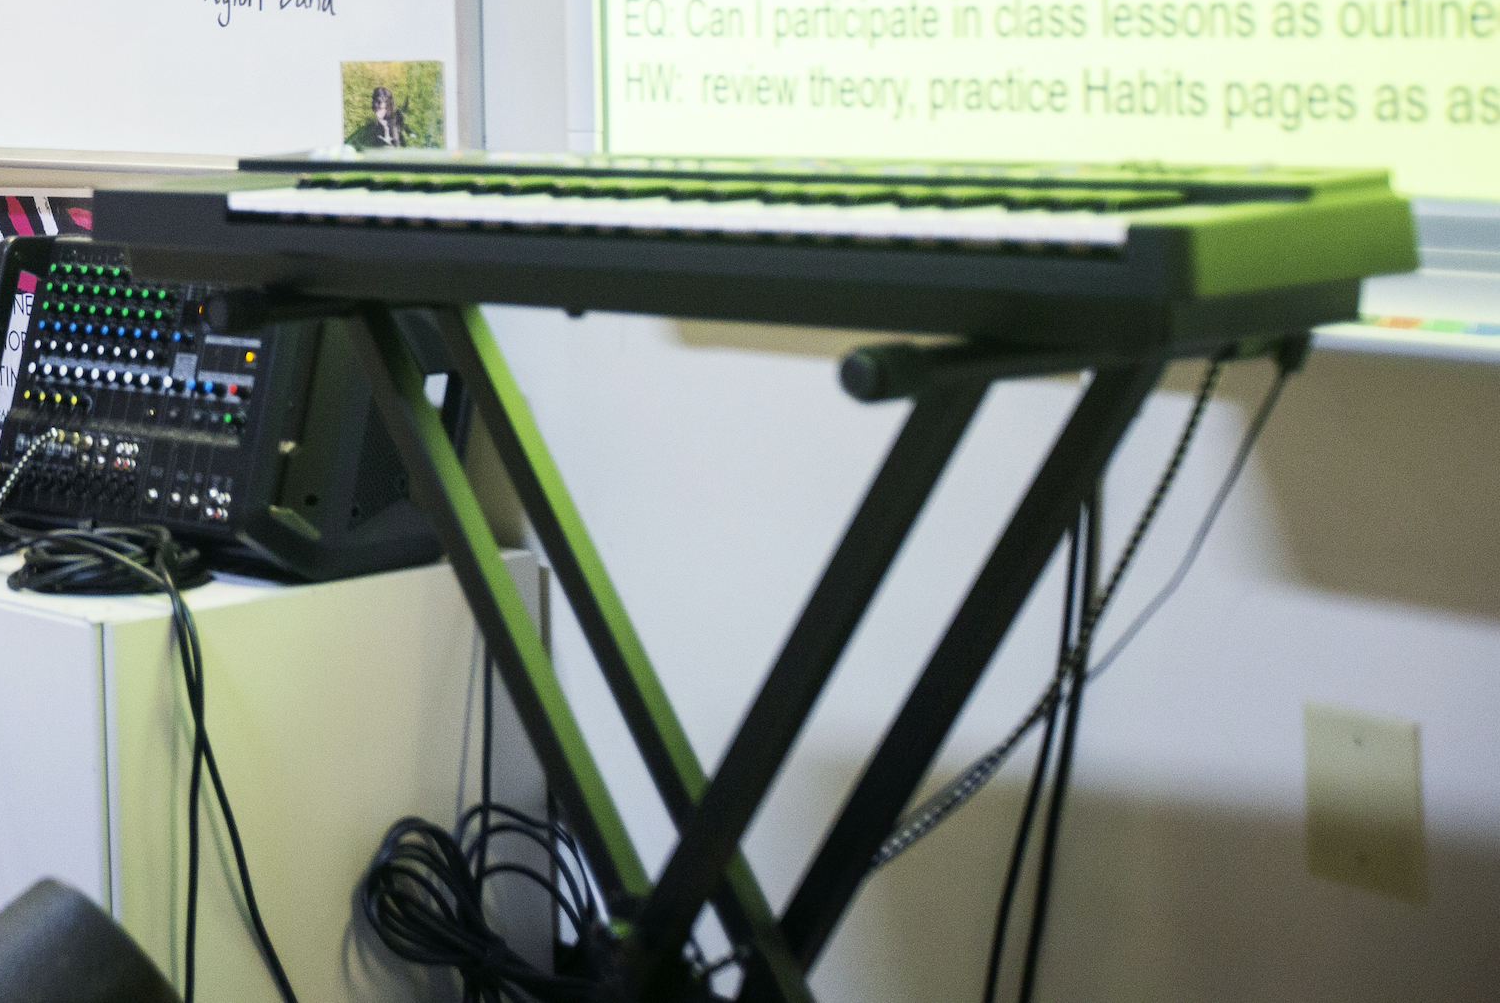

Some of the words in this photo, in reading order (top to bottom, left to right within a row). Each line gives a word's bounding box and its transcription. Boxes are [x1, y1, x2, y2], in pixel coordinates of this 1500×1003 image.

[1272, 0, 1323, 39] as
[625, 62, 682, 104] HW:
[702, 64, 796, 106] review
[809, 65, 917, 121] theory,
[928, 67, 1070, 122] practice
[1082, 67, 1208, 117] Habits
[1224, 79, 1358, 132] pages
[1373, 82, 1429, 124] as
